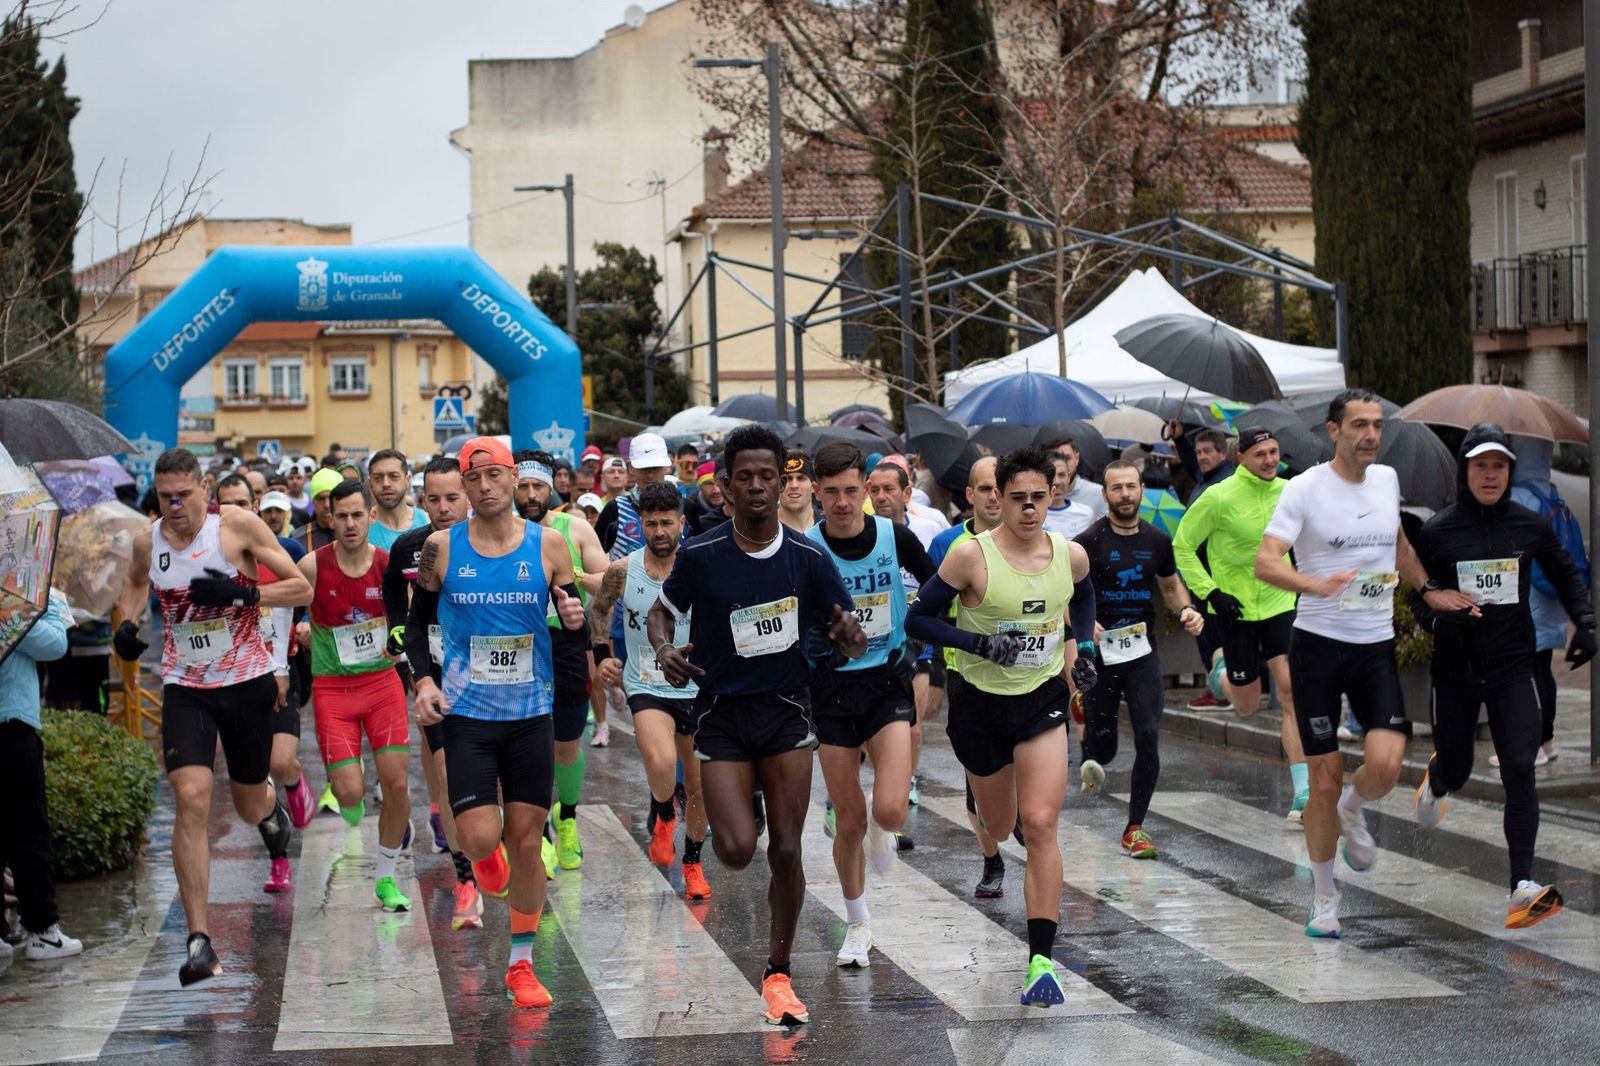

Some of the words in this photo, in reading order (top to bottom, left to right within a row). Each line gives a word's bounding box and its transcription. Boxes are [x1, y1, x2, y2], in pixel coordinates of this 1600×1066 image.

[332, 271, 404, 287] Diputación
[332, 290, 347, 302] de
[350, 288, 403, 302] Granada
[461, 283, 548, 360] DEPORTES
[152, 288, 235, 372] DEPORTES
[458, 564, 477, 577] als
[842, 568, 891, 593] erja
[1476, 573, 1502, 589] 504
[451, 592, 539, 605] TROTASIERRA
[855, 607, 873, 623] 32
[753, 616, 783, 636] 190
[188, 633, 211, 650] 101
[353, 631, 374, 648] 123
[1019, 636, 1045, 652] 524
[1118, 637, 1131, 649] 76
[490, 650, 517, 666] 382
